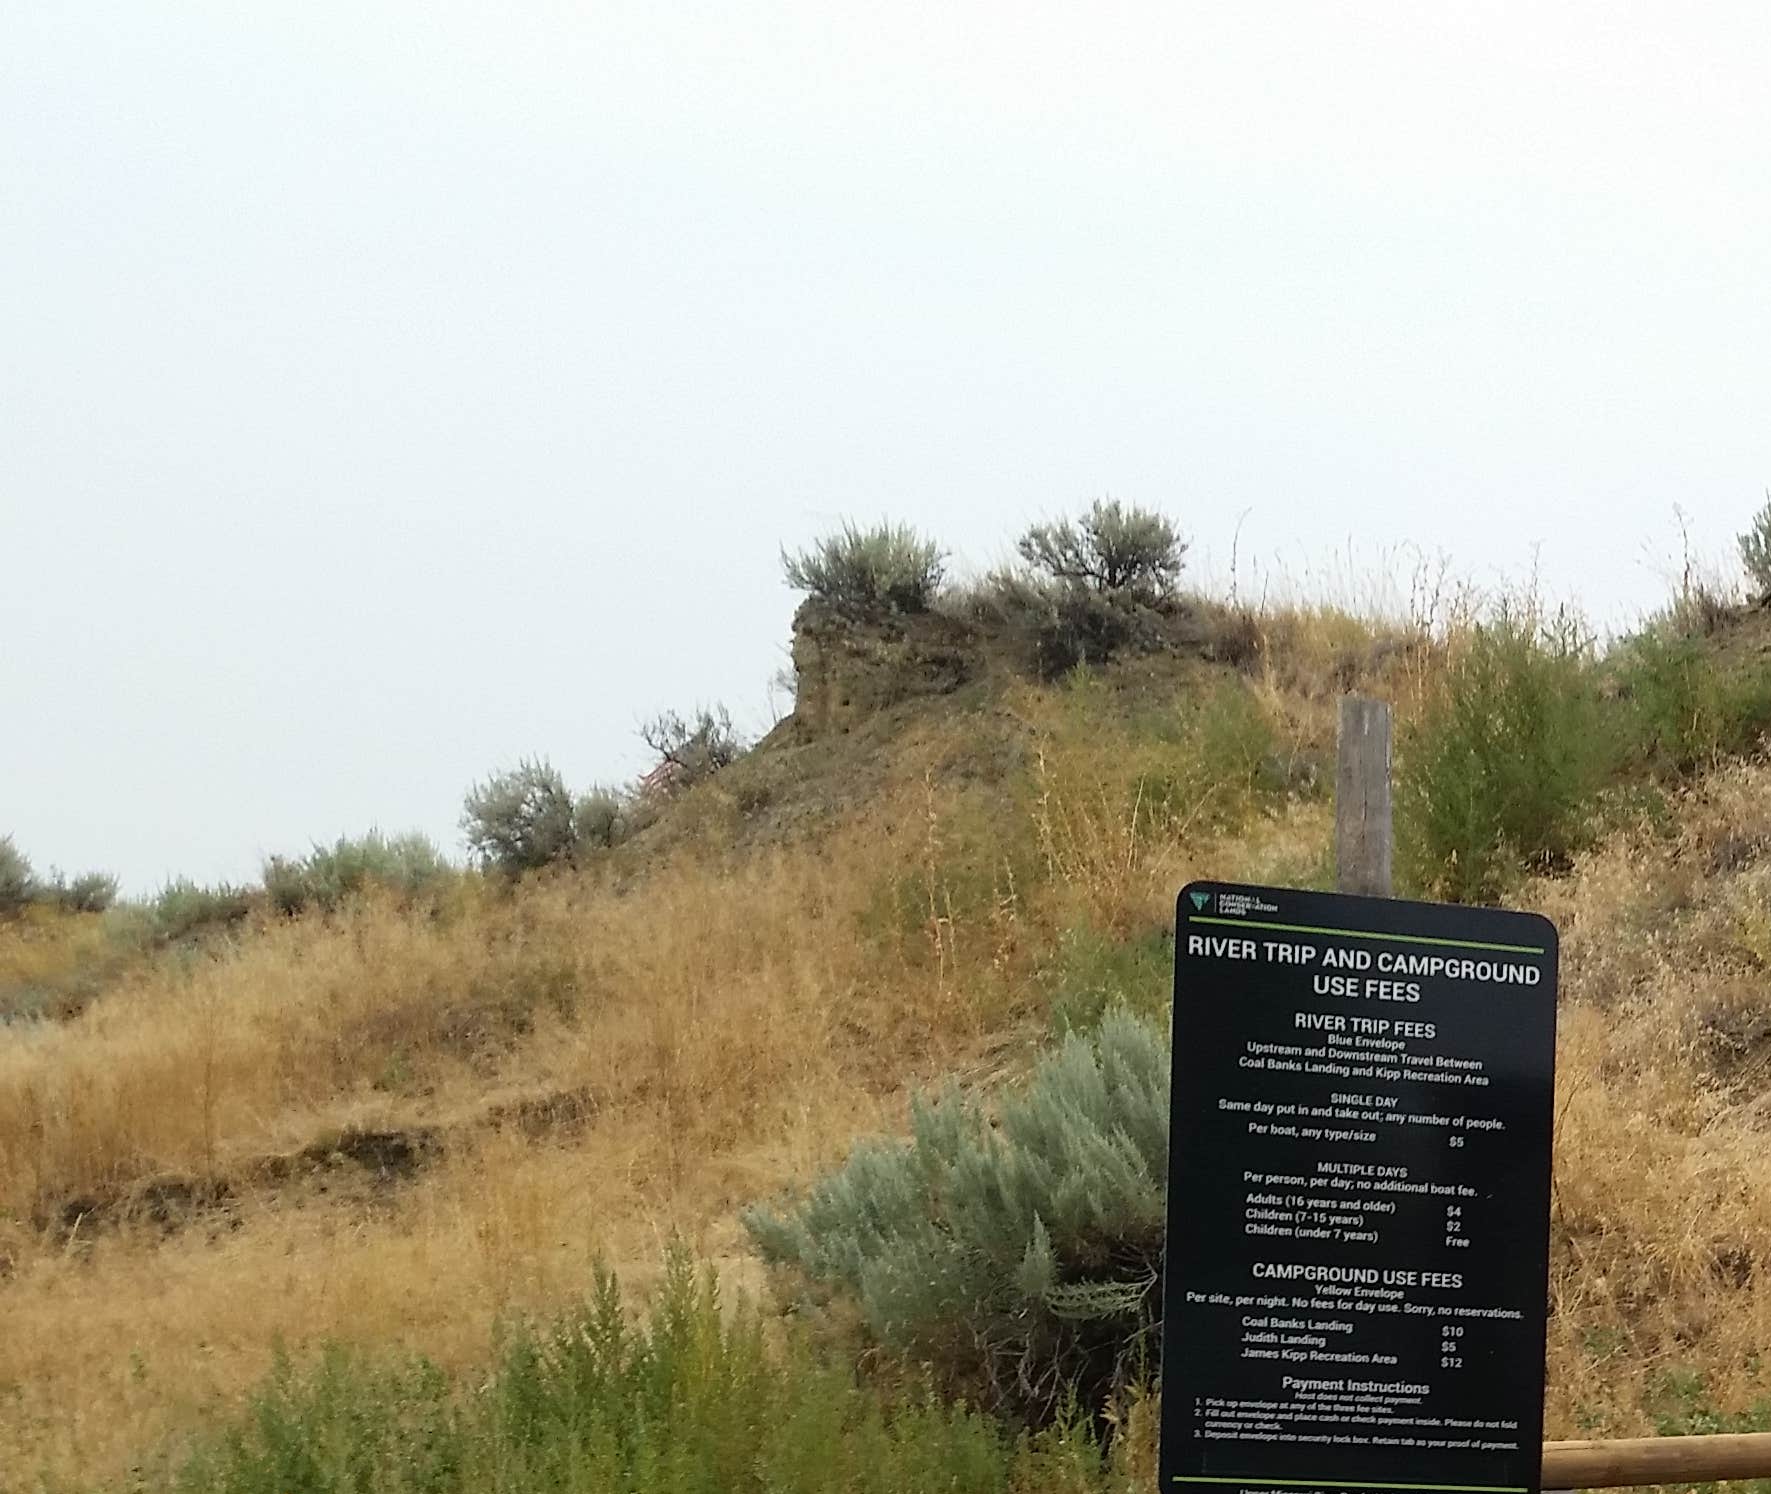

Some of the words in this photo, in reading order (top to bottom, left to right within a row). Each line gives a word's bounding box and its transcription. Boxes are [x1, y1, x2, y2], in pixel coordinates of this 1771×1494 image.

[1189, 935, 1256, 960] RIVER
[1263, 942, 1316, 964] TRIP
[1322, 948, 1371, 970] AND
[1378, 953, 1540, 985] CAMPGROUND
[1314, 975, 1359, 997] USE
[1365, 980, 1420, 1002] FEES
[1295, 1013, 1346, 1031] RIVER
[1350, 1017, 1390, 1034] TRIP
[1394, 1021, 1436, 1038] FEES
[1328, 1034, 1353, 1045] Blue
[1355, 1036, 1406, 1051] Envelope
[1247, 1041, 1302, 1056] Upstream
[1304, 1046, 1326, 1057] and
[1328, 1048, 1398, 1063] Downstream
[1400, 1053, 1433, 1066] Travel
[1436, 1056, 1482, 1070] Between
[1239, 1056, 1265, 1068] Coal
[1267, 1058, 1302, 1071] Banks
[1305, 1061, 1350, 1077] Landing
[1352, 1066, 1373, 1077] and
[1376, 1067, 1401, 1081] Kipp
[1403, 1069, 1462, 1083] Recreation
[1463, 1074, 1489, 1086] Area
[1331, 1093, 1373, 1106] SINGLE
[1375, 1096, 1398, 1107] DAY
[1219, 1099, 1251, 1111] Same
[1253, 1101, 1274, 1115] day
[1276, 1105, 1295, 1116] put
[1298, 1104, 1309, 1115] in
[1311, 1106, 1332, 1117] and
[1335, 1107, 1359, 1119] take
[1361, 1111, 1383, 1122] out;
[1385, 1113, 1407, 1125] any
[1408, 1114, 1450, 1125] number
[1452, 1116, 1464, 1127] of
[1466, 1118, 1505, 1131] people.
[1248, 1122, 1268, 1133] Per
[1270, 1123, 1299, 1138] boat,
[1301, 1128, 1323, 1140] any
[1324, 1129, 1376, 1142] type/size
[1449, 1136, 1464, 1147] $5
[1317, 1162, 1375, 1176] MULTIPLE
[1377, 1166, 1408, 1178] DAYS
[1244, 1171, 1264, 1182] Per
[1265, 1175, 1308, 1187] person,
[1310, 1178, 1328, 1188] per
[1330, 1177, 1354, 1190] day;
[1357, 1181, 1371, 1189] no
[1373, 1180, 1429, 1193] additional
[1430, 1183, 1455, 1195] boat
[1458, 1185, 1477, 1197] fee.
[1246, 1193, 1283, 1205] Adults
[1285, 1195, 1305, 1208] (16
[1307, 1199, 1337, 1209] years
[1339, 1200, 1361, 1210] and
[1362, 1201, 1396, 1214] older)
[1447, 1205, 1461, 1217] $4
[1245, 1208, 1293, 1221] Children
[1295, 1211, 1327, 1224] (7-15
[1329, 1215, 1364, 1227] years)
[1446, 1220, 1461, 1232] $2
[1245, 1223, 1292, 1236] Children
[1295, 1226, 1332, 1238] (under
[1333, 1228, 1341, 1239] 7
[1343, 1231, 1378, 1243] years)
[1446, 1236, 1470, 1247] Free
[1253, 1263, 1379, 1283] CAMPGROUND
[1383, 1270, 1417, 1286] USE
[1421, 1272, 1462, 1288] FEES
[1315, 1284, 1352, 1296] Yellow
[1354, 1286, 1404, 1300] Envelope
[1186, 1291, 1207, 1302] Per
[1209, 1293, 1233, 1305] site,
[1235, 1296, 1255, 1307] per
[1256, 1295, 1289, 1308] night.
[1292, 1297, 1309, 1308] No
[1310, 1297, 1335, 1309] fees
[1337, 1299, 1354, 1310] for
[1355, 1300, 1376, 1314] day
[1378, 1304, 1401, 1312] use.
[1404, 1303, 1435, 1317] Sorry,
[1437, 1307, 1452, 1315] no
[1454, 1307, 1523, 1319] reservations.
[1242, 1316, 1268, 1327] Coal
[1270, 1317, 1306, 1329] Banks
[1308, 1319, 1353, 1334] Landing
[1442, 1325, 1464, 1337] $10
[1241, 1332, 1278, 1343] Judith
[1280, 1334, 1326, 1348] Landing
[1441, 1341, 1456, 1352] $5
[1241, 1348, 1279, 1359] James
[1281, 1349, 1308, 1362] Kipp
[1310, 1350, 1370, 1363] Recreation
[1371, 1353, 1397, 1364] Area
[1441, 1356, 1462, 1368] $12
[1282, 1376, 1344, 1392] Payment
[1347, 1379, 1430, 1394] Instructions
